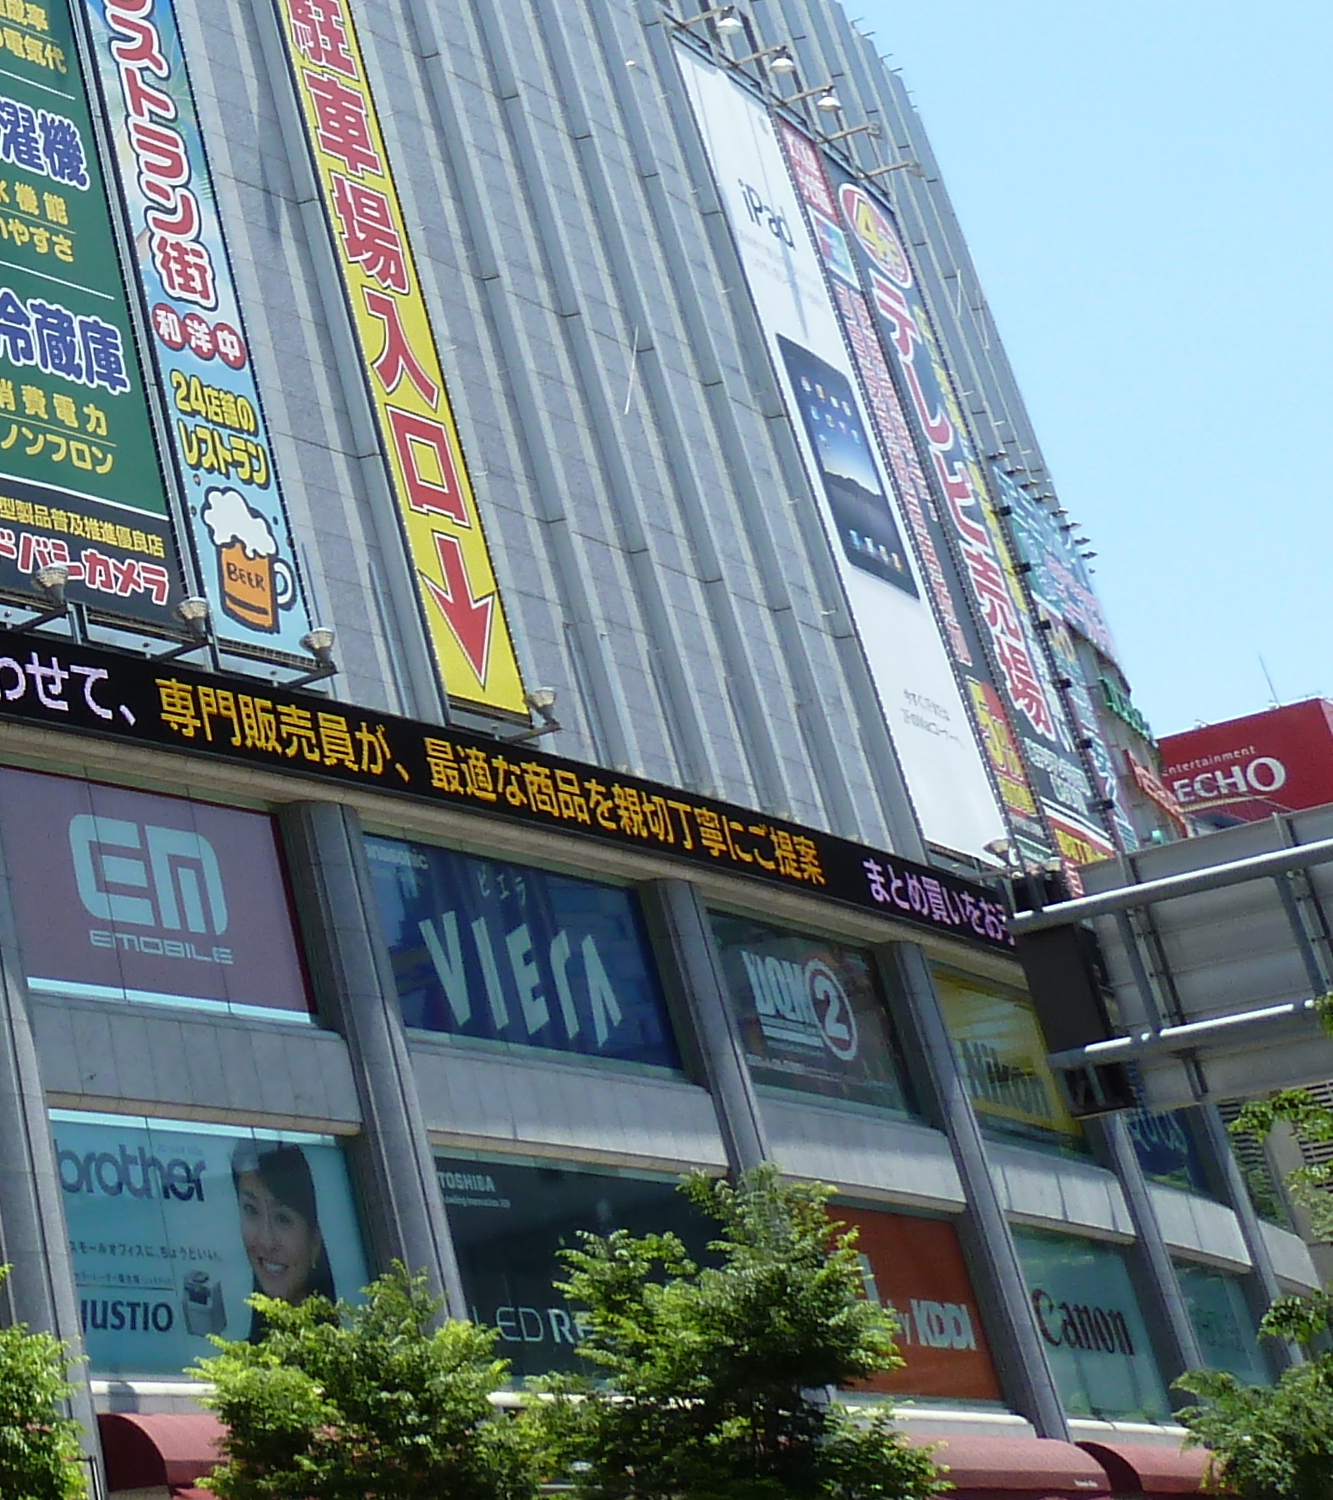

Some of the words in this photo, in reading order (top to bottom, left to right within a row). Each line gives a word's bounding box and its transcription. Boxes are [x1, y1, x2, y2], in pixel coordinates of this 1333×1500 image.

[738, 177, 796, 251] iPad
[155, 306, 243, 363] 和洋中
[170, 370, 257, 436] 24店舗の
[0, 424, 114, 474] ノンフロン
[177, 421, 270, 488] レストラン
[225, 561, 266, 592] BEER
[53, 1138, 208, 1202] brother
[437, 1170, 496, 1192] TOSHIBA
[910, 1298, 977, 1351] KDDI
[1032, 1287, 1135, 1357] Canon
